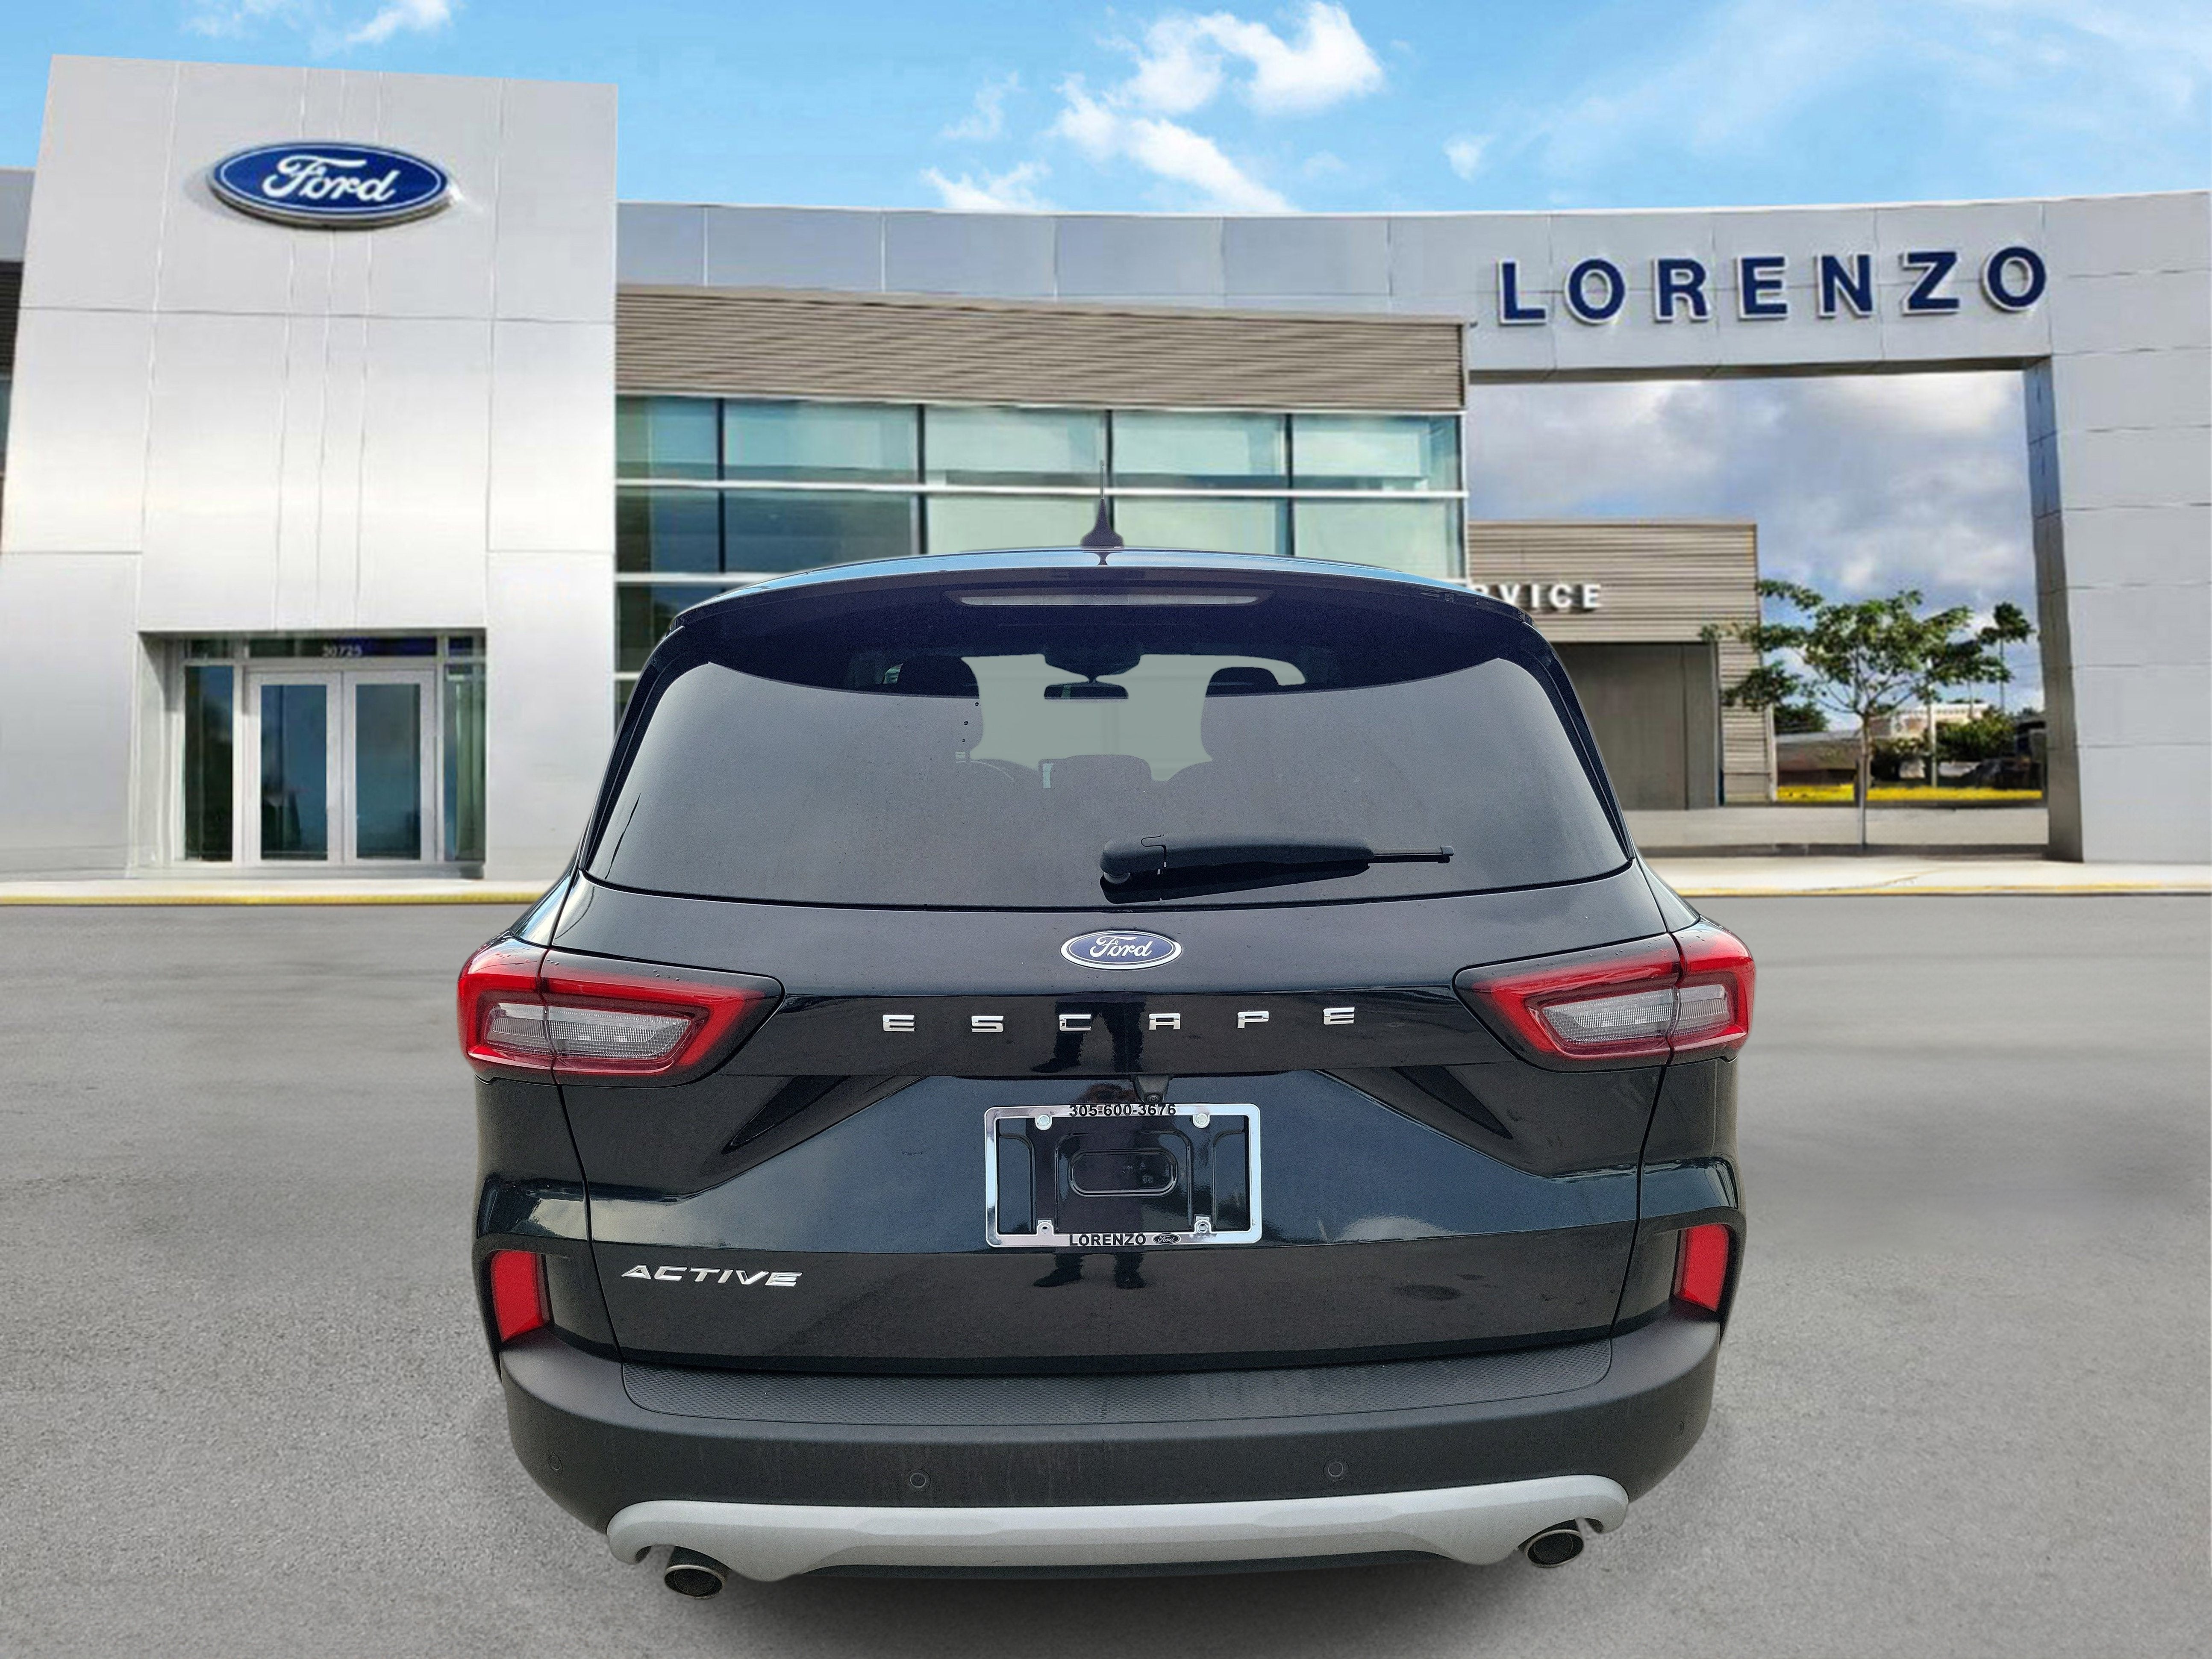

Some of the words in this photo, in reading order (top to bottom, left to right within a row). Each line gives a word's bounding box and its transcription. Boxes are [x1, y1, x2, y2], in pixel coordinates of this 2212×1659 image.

[262, 154, 400, 202] Ford
[1497, 247, 2047, 326] LORENZO
[1090, 935, 1153, 957] Ford
[882, 1006, 1355, 1032] ESCAPE
[1069, 1104, 1176, 1117] 305-600-3676
[1069, 1233, 1146, 1246] LORENZO
[621, 1265, 803, 1287] ACTIVE
